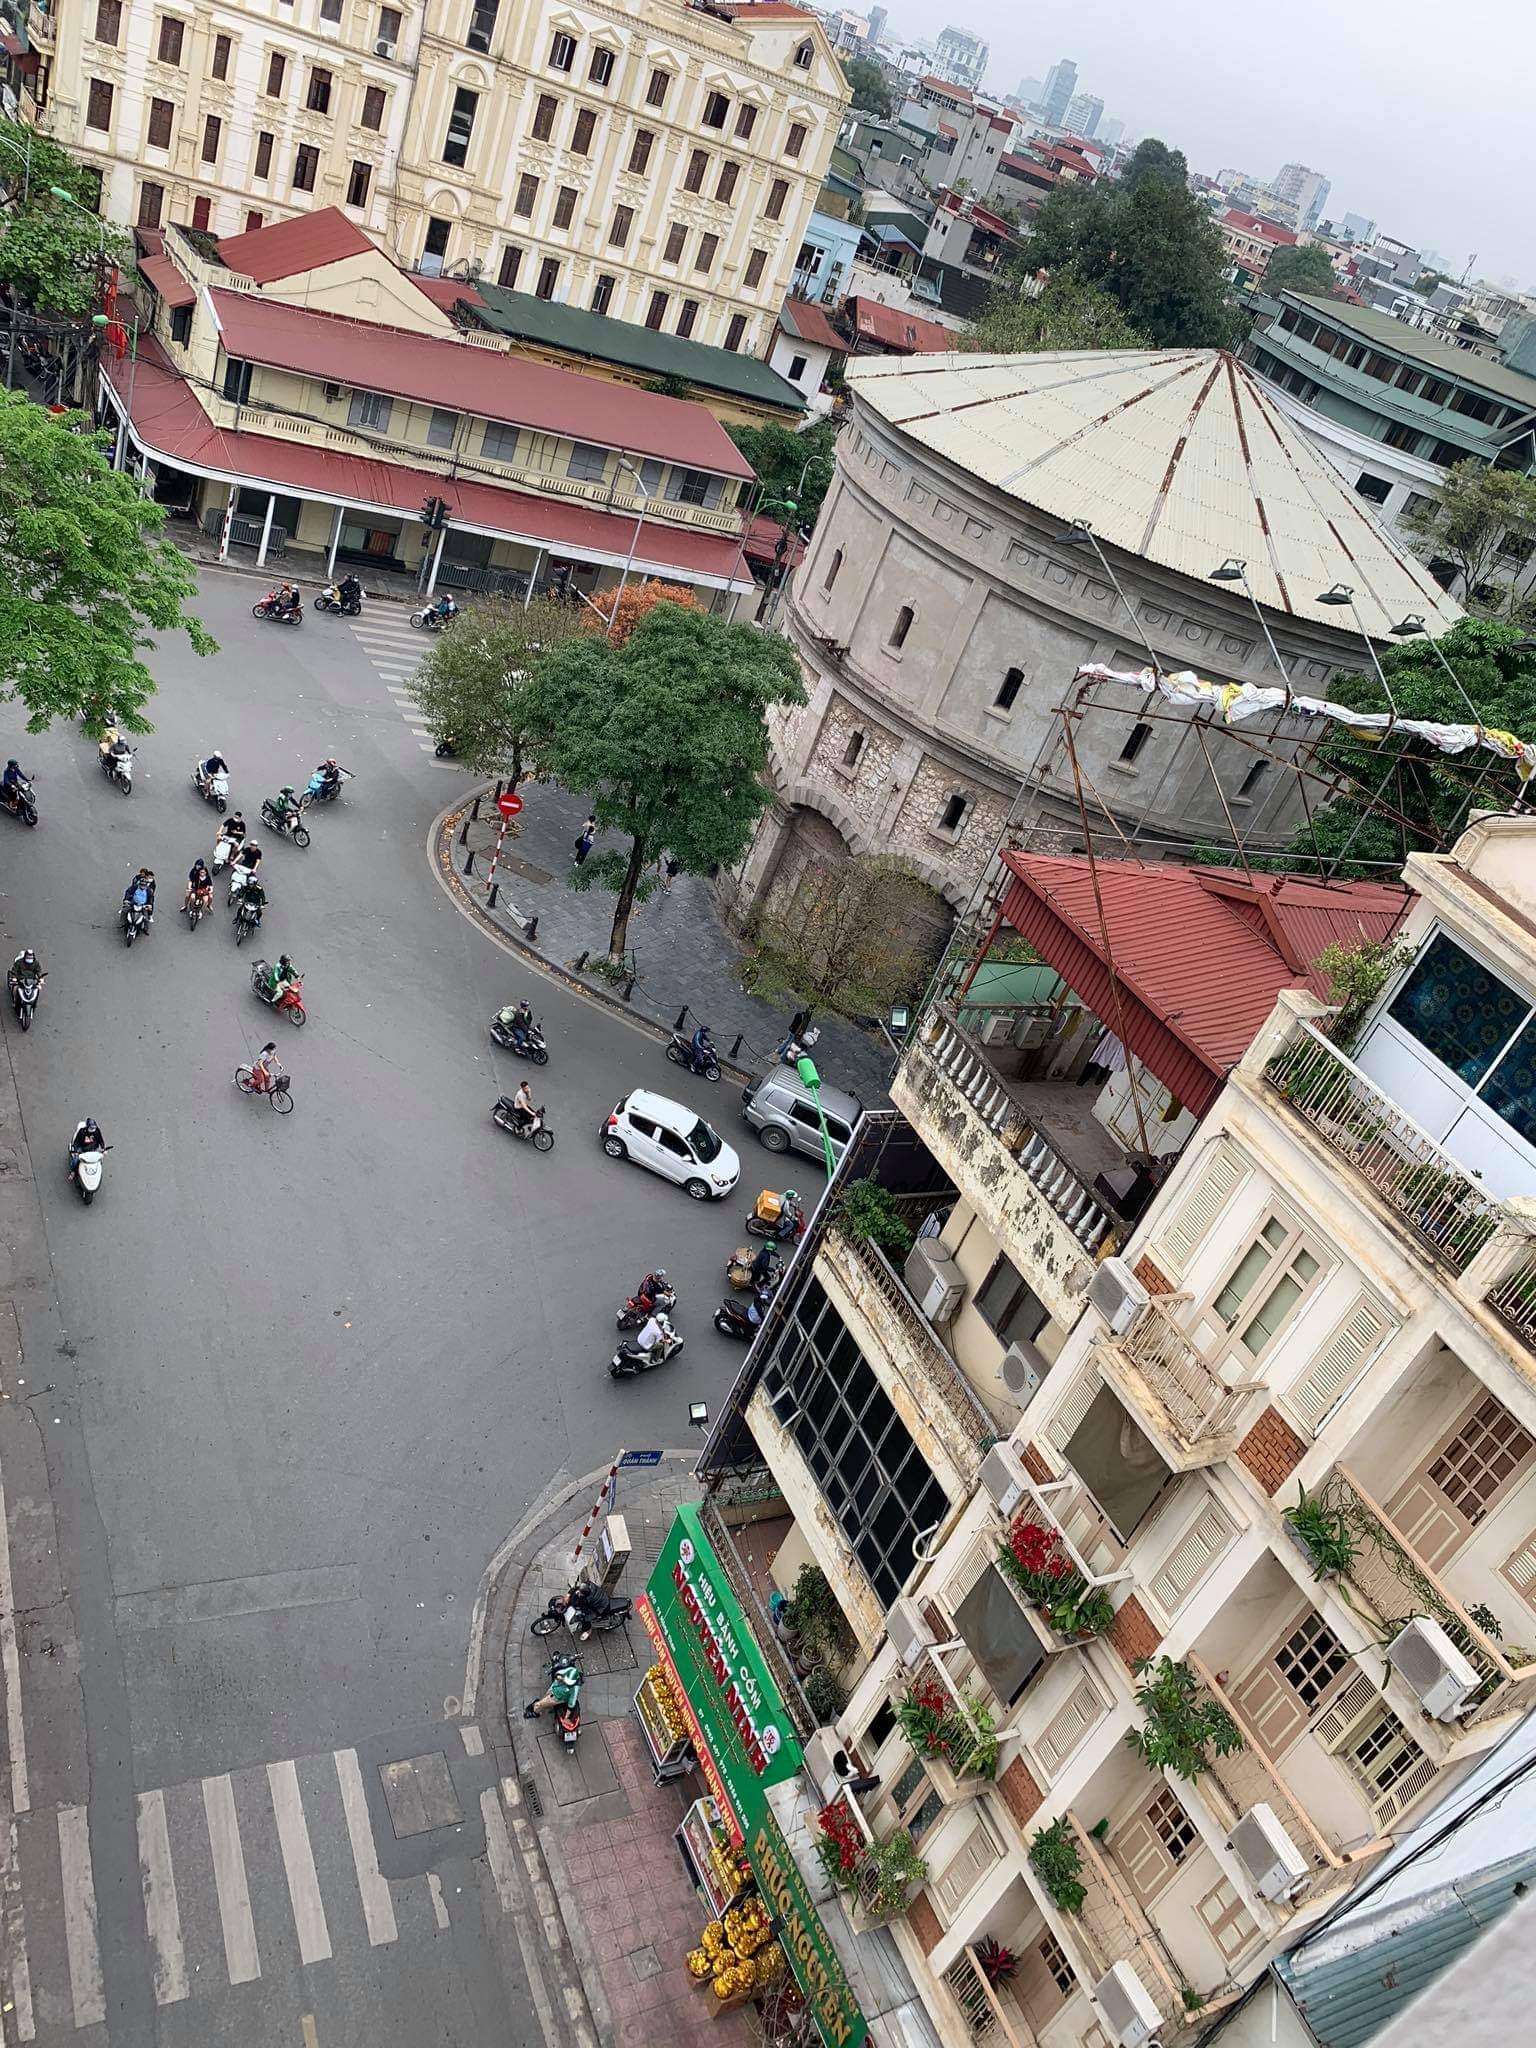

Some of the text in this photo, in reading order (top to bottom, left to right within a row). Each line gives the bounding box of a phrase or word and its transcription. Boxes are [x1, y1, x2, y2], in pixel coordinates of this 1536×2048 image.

[639, 1604, 654, 1633] BÁNH
[699, 1573, 759, 1709] HIỆU BÁNH CỐM
[726, 1681, 770, 1776] NINH
[755, 1830, 793, 1914] PHÚC
